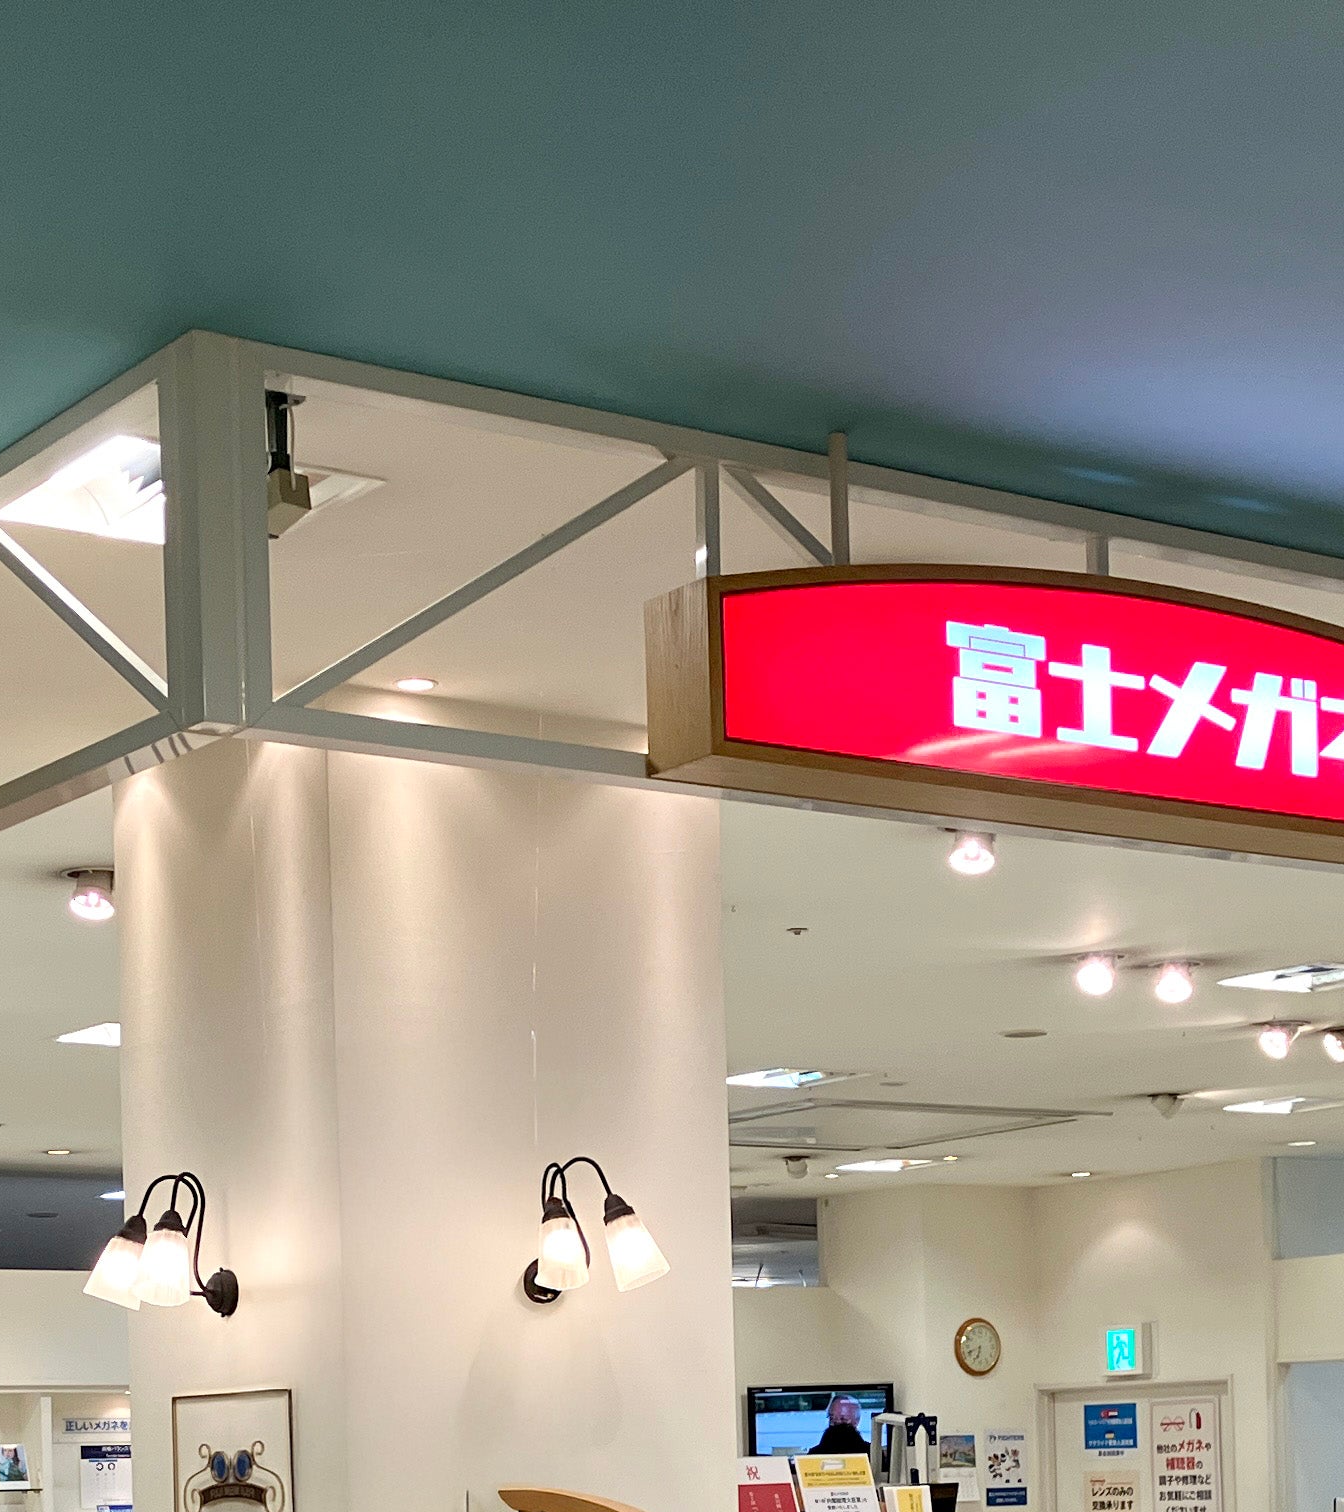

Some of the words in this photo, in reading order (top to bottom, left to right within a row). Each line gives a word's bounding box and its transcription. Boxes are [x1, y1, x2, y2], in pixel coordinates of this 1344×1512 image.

[65, 1420, 131, 1431] 正しいメガネを
[1166, 1456, 1203, 1471] 補聴器の
[745, 1464, 761, 1481] 祝
[1091, 1486, 1134, 1497] レンズのみの
